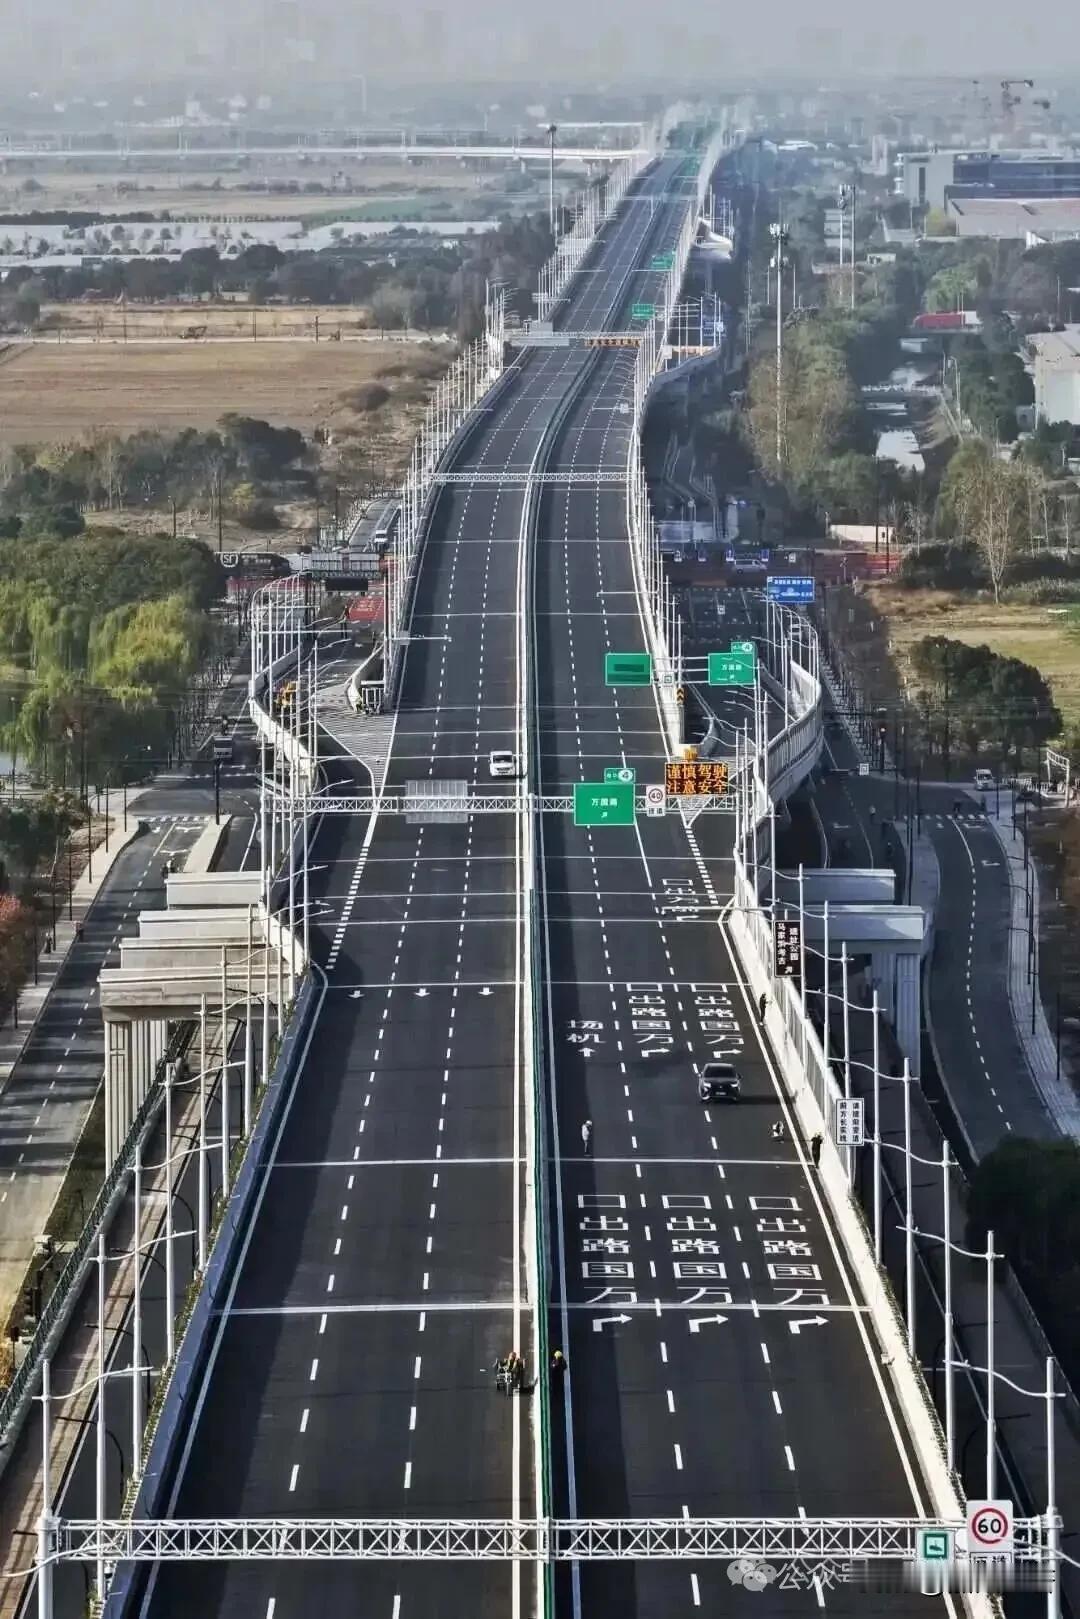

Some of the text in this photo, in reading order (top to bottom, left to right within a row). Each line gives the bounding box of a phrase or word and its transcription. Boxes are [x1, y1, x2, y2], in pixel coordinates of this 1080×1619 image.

[667, 764, 728, 779] 谨慎驾驶
[667, 779, 728, 794] 注意安全
[651, 792, 662, 800] 40
[977, 1518, 1001, 1534] 60
